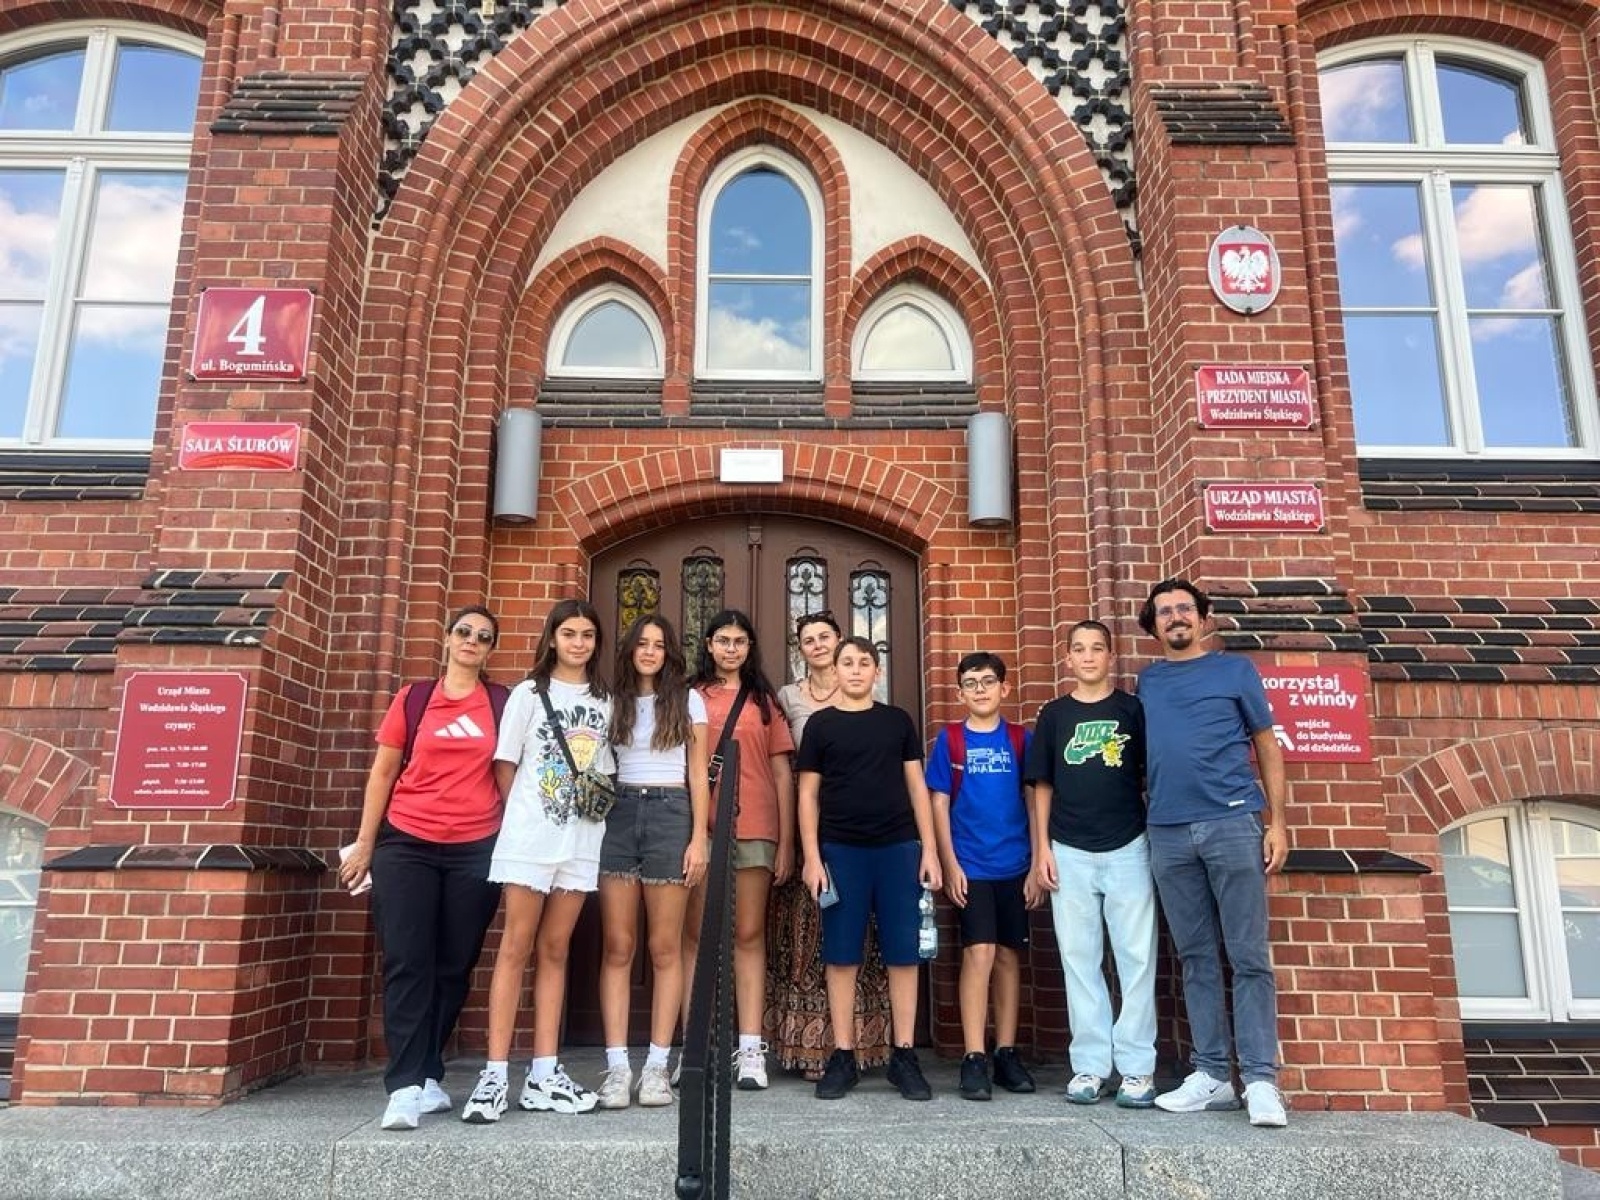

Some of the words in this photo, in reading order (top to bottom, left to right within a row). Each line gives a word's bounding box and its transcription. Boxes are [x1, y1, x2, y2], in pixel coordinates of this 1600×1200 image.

[227, 295, 267, 356] 4
[201, 360, 216, 371] ul.
[219, 360, 294, 374] Bogumińska
[1216, 371, 1245, 384] RADA
[1248, 371, 1290, 386] MIEJSKA
[1207, 389, 1268, 404] PREZYDENT
[1269, 389, 1309, 404] MIASTA
[1210, 408, 1262, 420] Wodzisławia
[1263, 406, 1303, 423] Śląskiego
[185, 438, 223, 453] SALA
[227, 435, 293, 453] ŚLUBÓW
[1210, 491, 1261, 507] URZĄD
[1263, 491, 1317, 505] MIASTA
[1215, 510, 1272, 521] Wodzisławia
[1273, 508, 1315, 524] Śląskiego
[157, 687, 182, 697] Urząd
[183, 686, 211, 696] Miasta
[1288, 693, 1299, 706] z
[1302, 690, 1358, 710] windy
[1295, 719, 1330, 730] wejście
[1076, 722, 1116, 743] NIKE
[1296, 731, 1308, 740] do
[1310, 731, 1351, 742] budynku
[1297, 743, 1310, 752] od
[1310, 743, 1361, 753] dziedzińca
